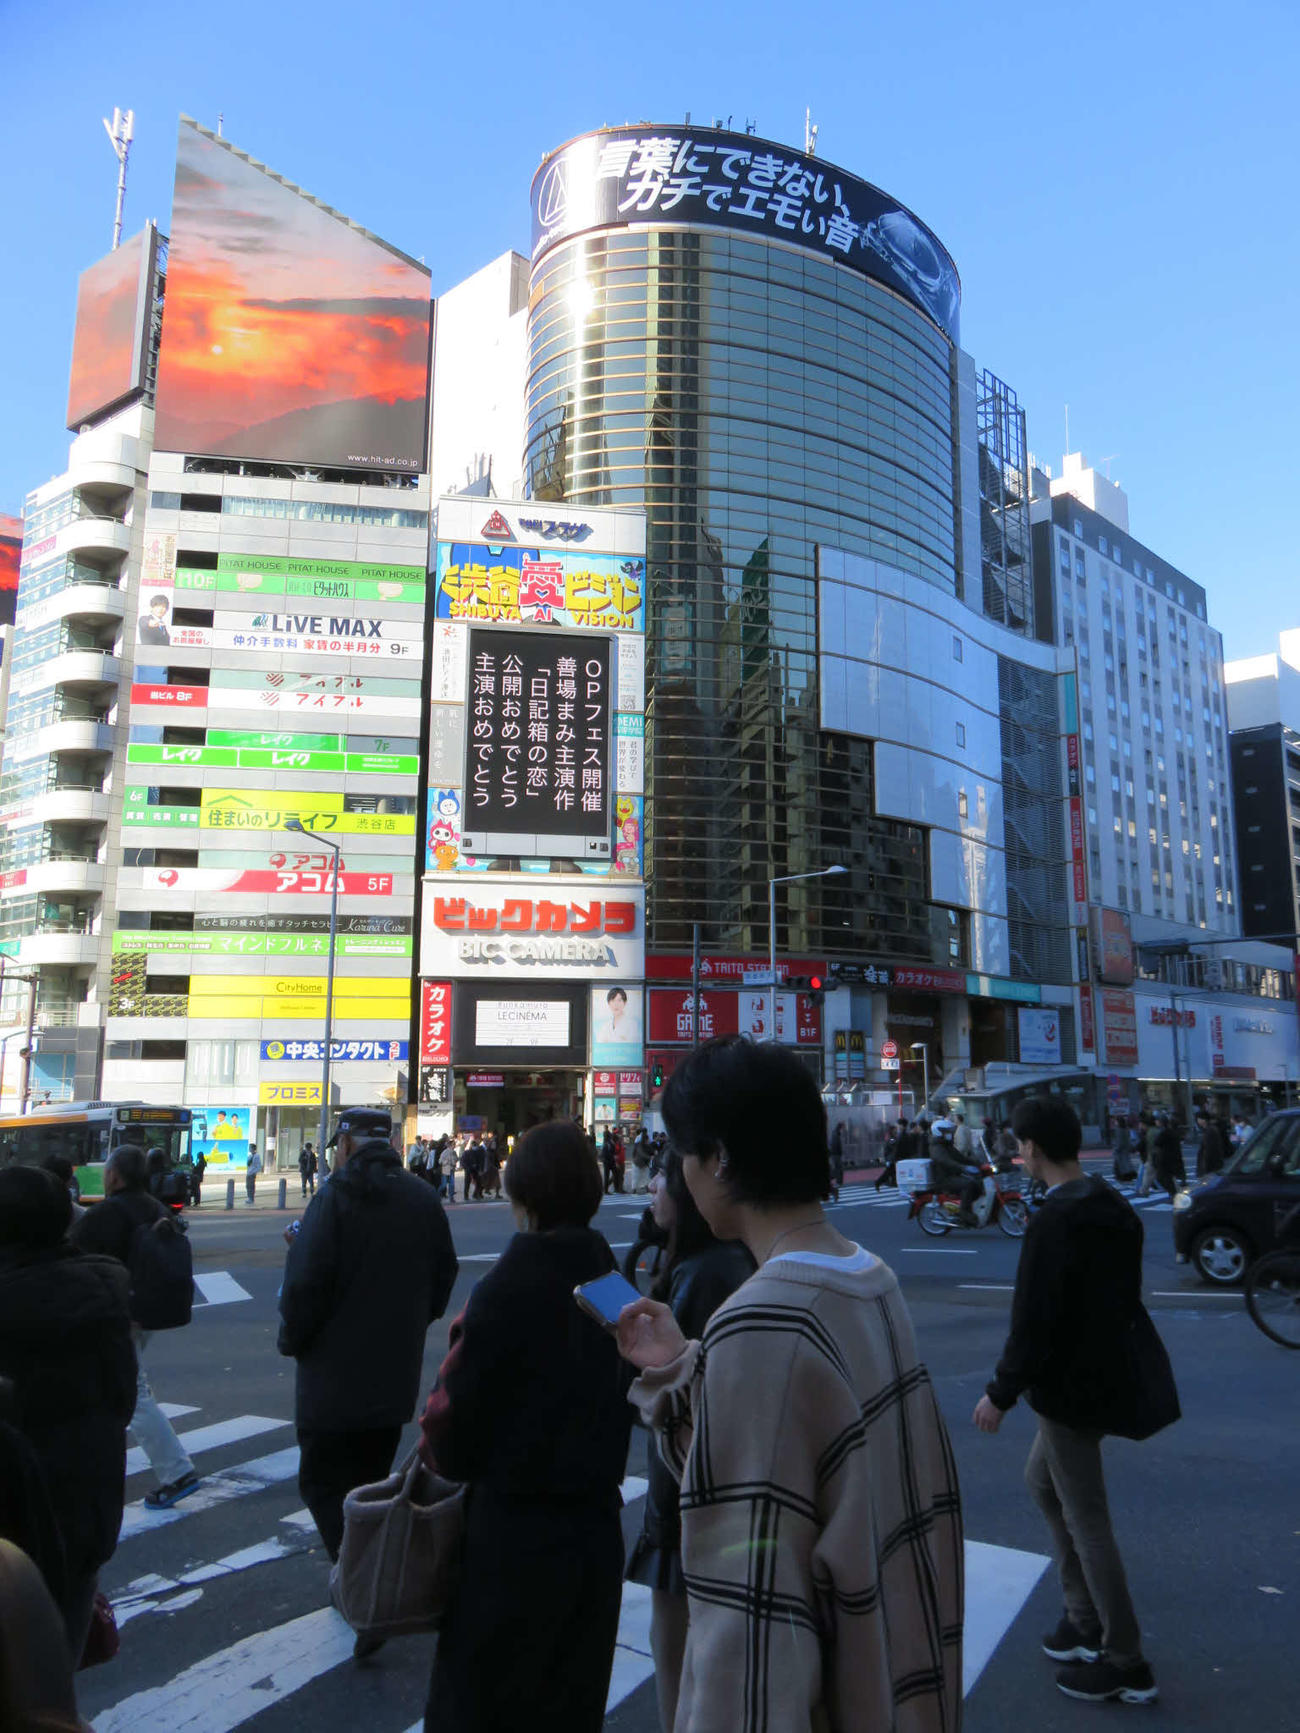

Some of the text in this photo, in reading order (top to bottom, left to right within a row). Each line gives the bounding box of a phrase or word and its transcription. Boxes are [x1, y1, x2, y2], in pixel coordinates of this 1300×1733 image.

[600, 136, 851, 217] 言葉にできない、
[617, 178, 859, 254] ガチでエモい音
[347, 455, 418, 467] www.hit-ad.co.jp
[247, 561, 281, 571] HOUSE
[288, 563, 350, 576] PITAT HOUSE
[361, 569, 423, 580] PITAT HOUSE
[449, 603, 634, 628] SHIBUYA AI VISION
[272, 614, 382, 638] LiVE MAX
[390, 643, 409, 655] 9F
[296, 693, 364, 708] アイフル
[473, 652, 496, 807] 主演おめでとう
[500, 654, 524, 808] 公開おめでとう
[525, 668, 552, 798] 「日記箱の恋」
[553, 656, 578, 811] 善場まみ主演作
[580, 658, 603, 813] OPフェス開催
[261, 734, 293, 745] レイク
[374, 739, 390, 752] 7F
[162, 748, 202, 761] レイク
[272, 752, 311, 766] レイク
[130, 790, 143, 801] 6F
[208, 810, 396, 831] 住まいのリライフ 渋谷店
[291, 855, 346, 871] アコム
[276, 873, 389, 893] アコム 5F
[434, 897, 636, 933] ビックカメラ
[459, 938, 610, 961] BIC CAMERA
[714, 963, 743, 973] TAITO
[896, 972, 931, 986] カラオケ
[276, 982, 323, 993] CityHome
[119, 998, 135, 1008] 3F
[427, 986, 445, 1053] カラオケ
[800, 1027, 816, 1037] B1F
[267, 1087, 320, 1100] プロミス
